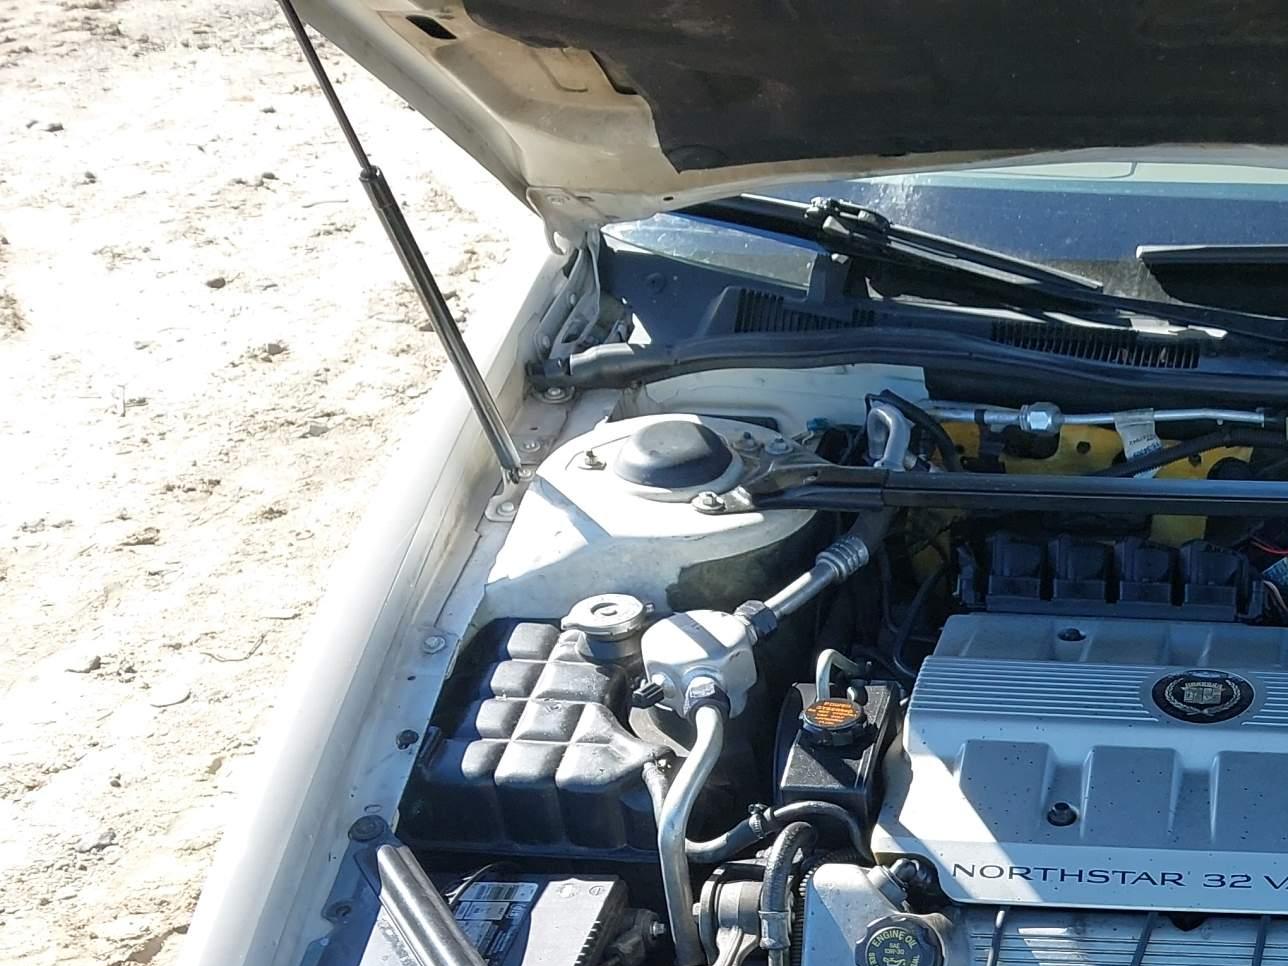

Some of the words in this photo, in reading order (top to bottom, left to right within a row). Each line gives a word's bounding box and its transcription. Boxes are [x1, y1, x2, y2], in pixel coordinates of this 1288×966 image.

[952, 863, 1186, 888] NORTHSTAR
[1202, 872, 1253, 890] 32
[872, 930, 905, 947] ENGINE
[905, 935, 917, 949] OIL
